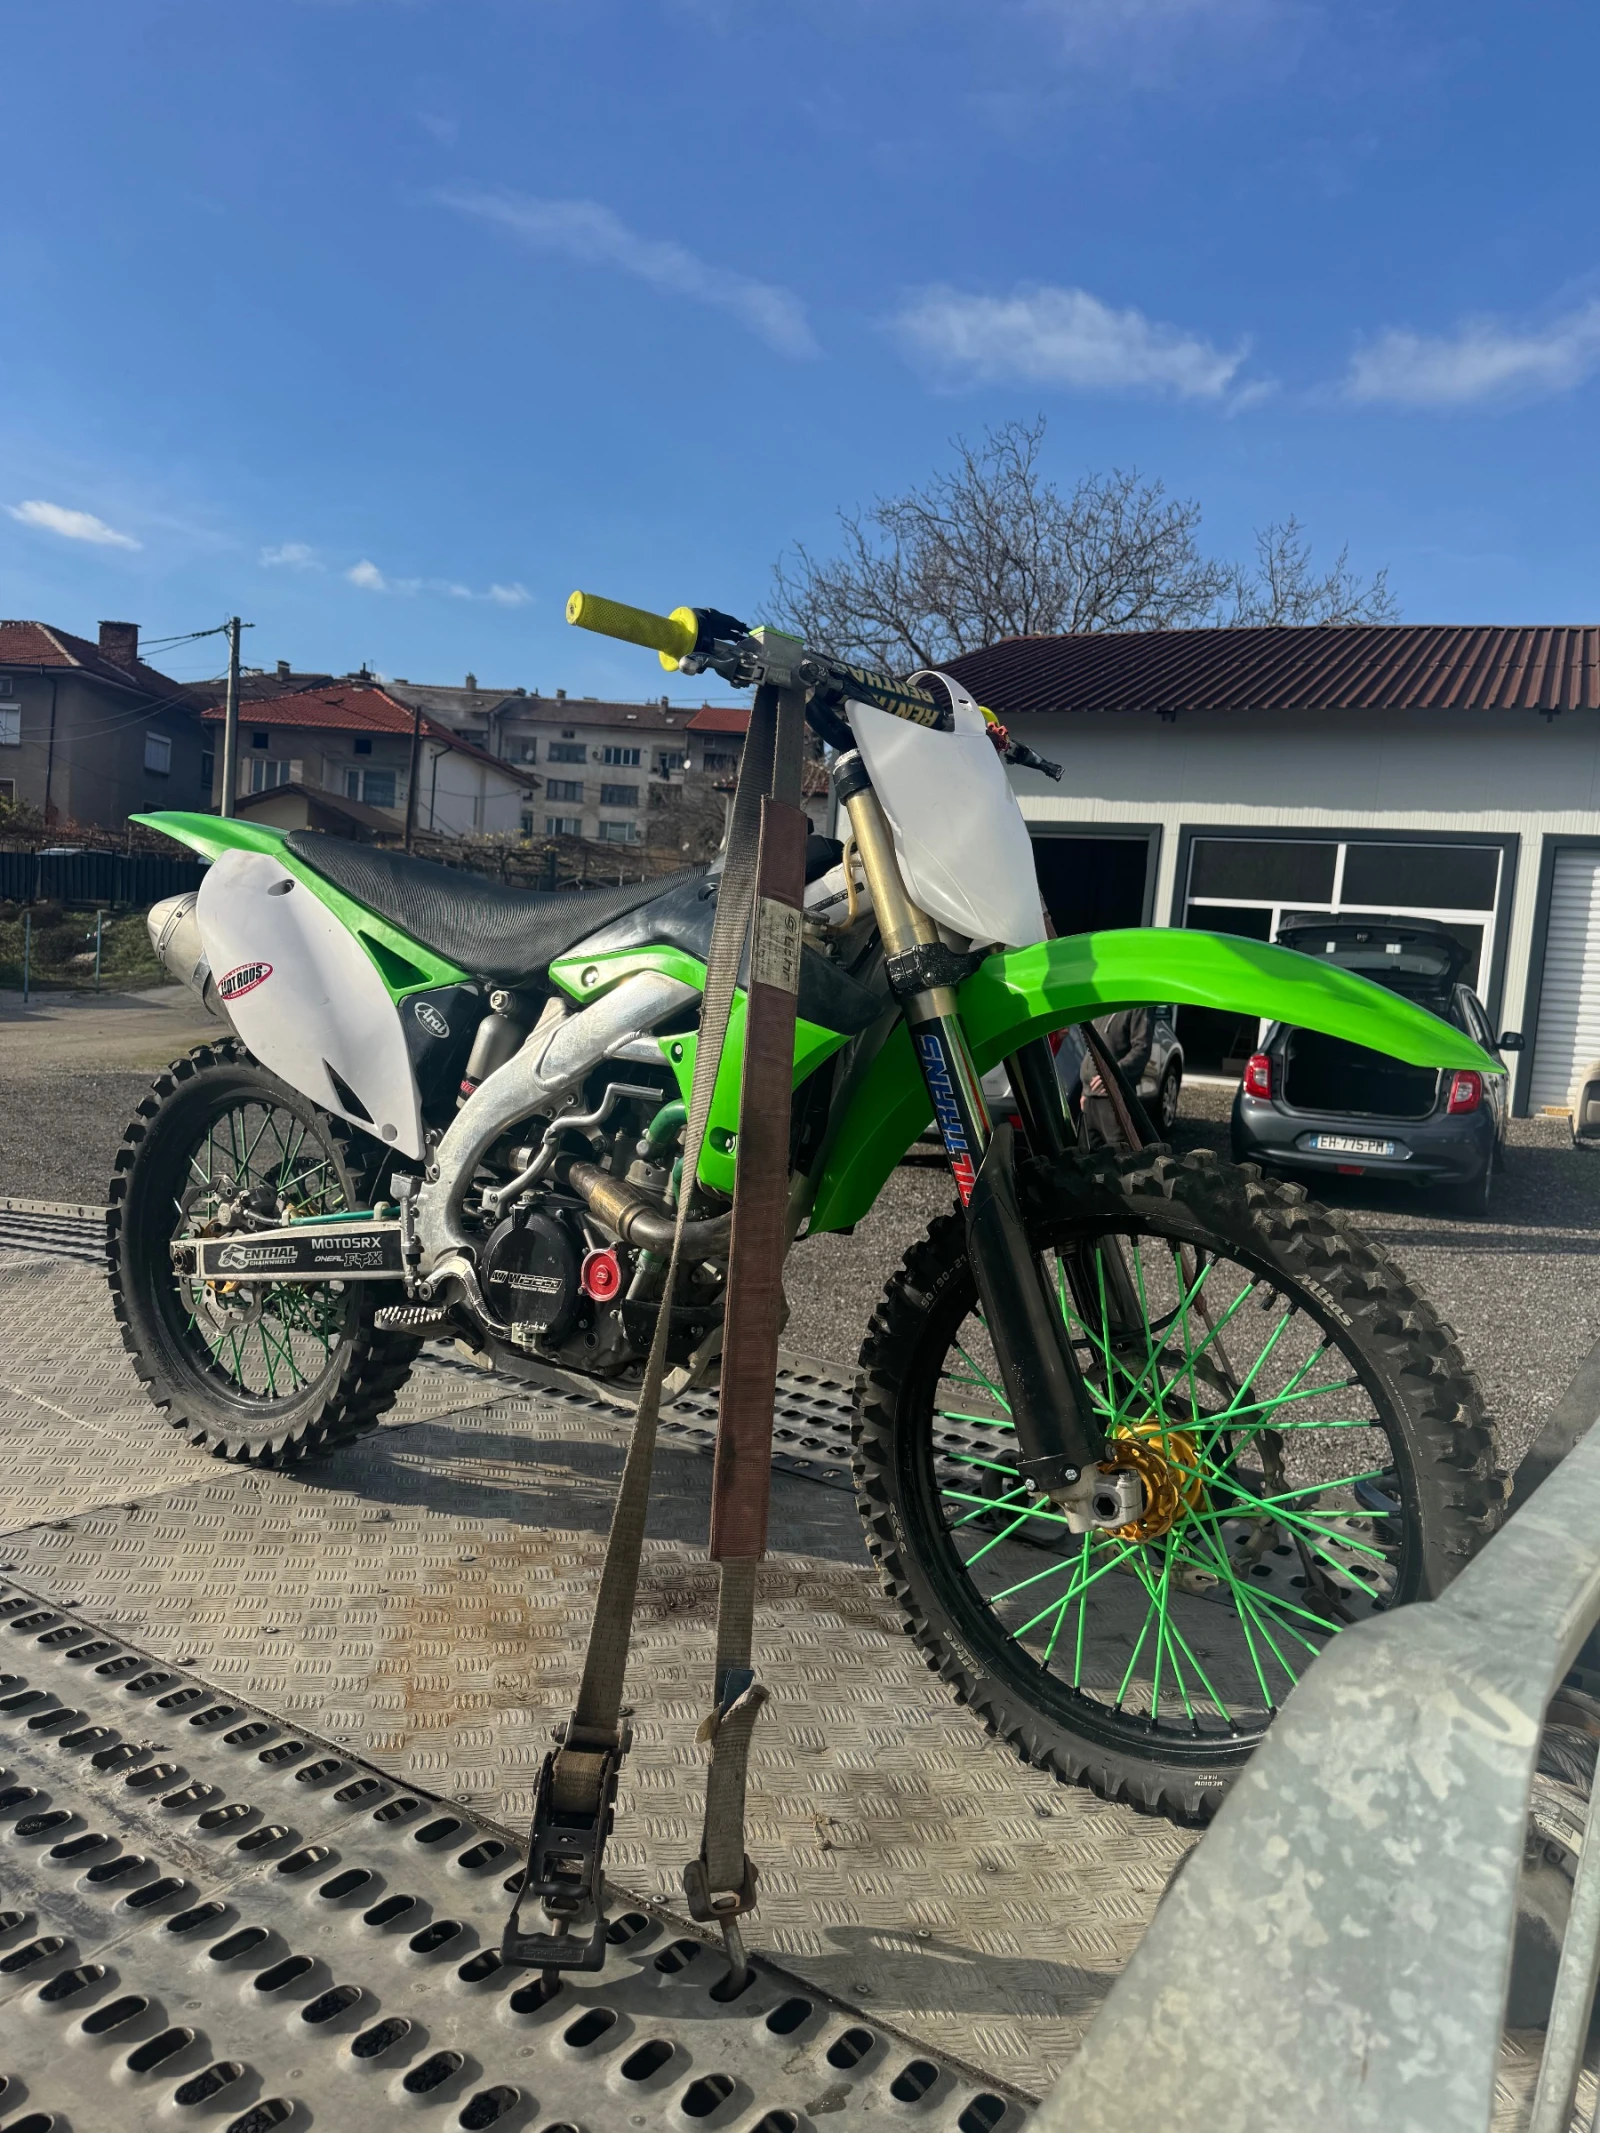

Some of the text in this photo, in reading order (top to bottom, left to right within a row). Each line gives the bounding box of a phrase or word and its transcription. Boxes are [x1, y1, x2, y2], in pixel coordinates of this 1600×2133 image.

[237, 965, 262, 988] RODS
[416, 1008, 447, 1033] Arai
[918, 1034, 969, 1154] TRANS
[311, 1236, 382, 1250] MOTOSRX
[1294, 1273, 1354, 1327] Mitas
